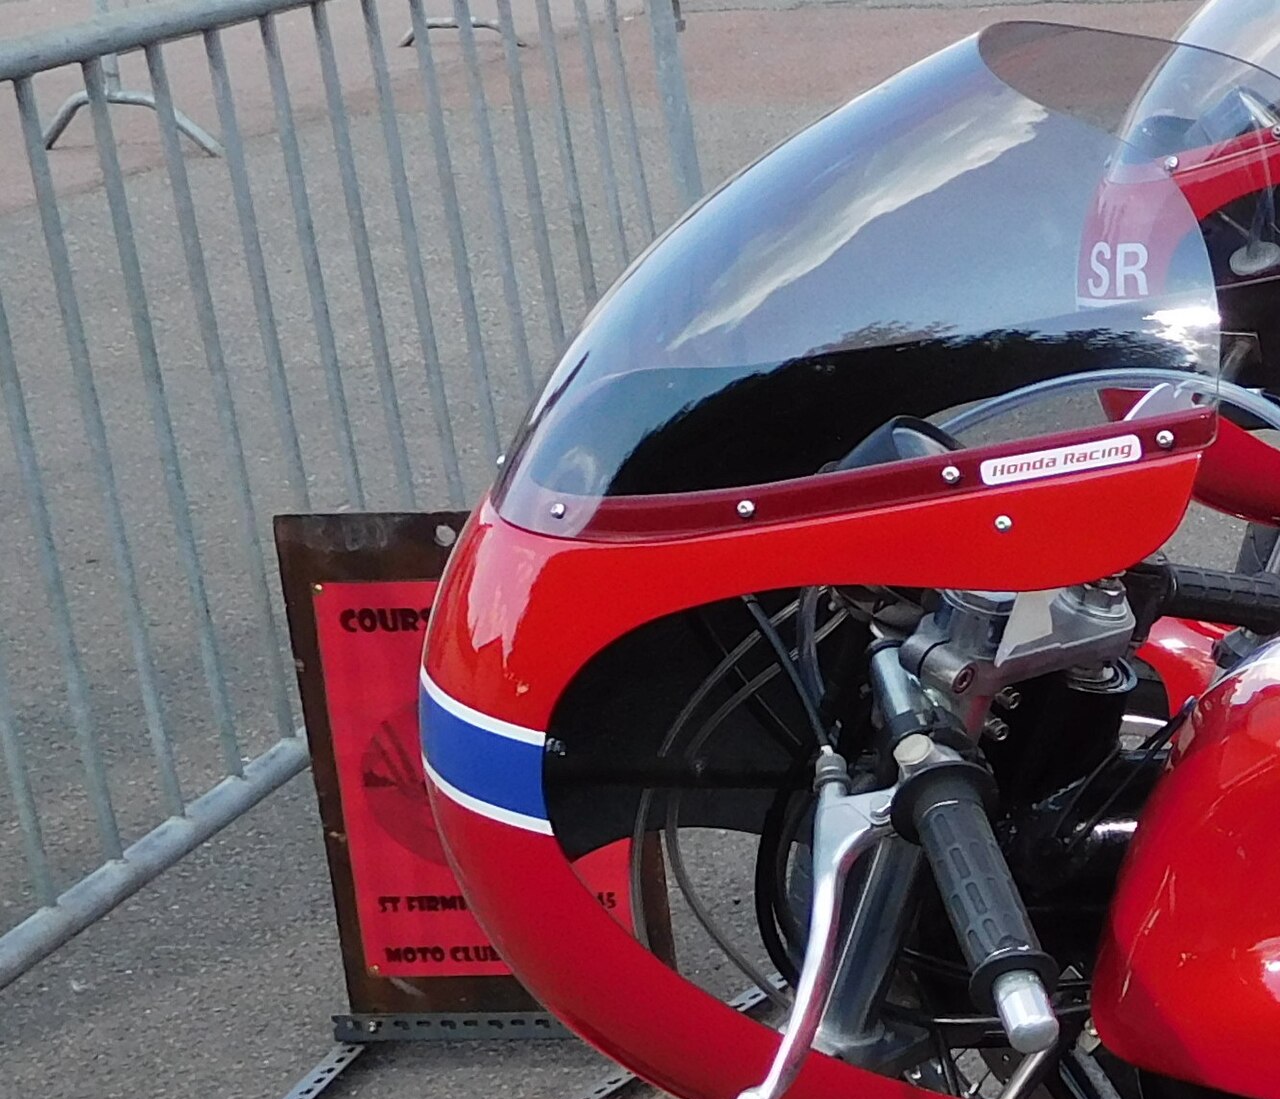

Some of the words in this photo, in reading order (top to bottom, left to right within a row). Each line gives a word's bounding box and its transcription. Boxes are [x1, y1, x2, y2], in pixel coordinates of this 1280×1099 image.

[1087, 241, 1149, 298] SR
[992, 456, 1058, 478] Honda
[1063, 443, 1133, 467] Racing
[378, 896, 400, 913] ST
[385, 945, 445, 963] MOTO
